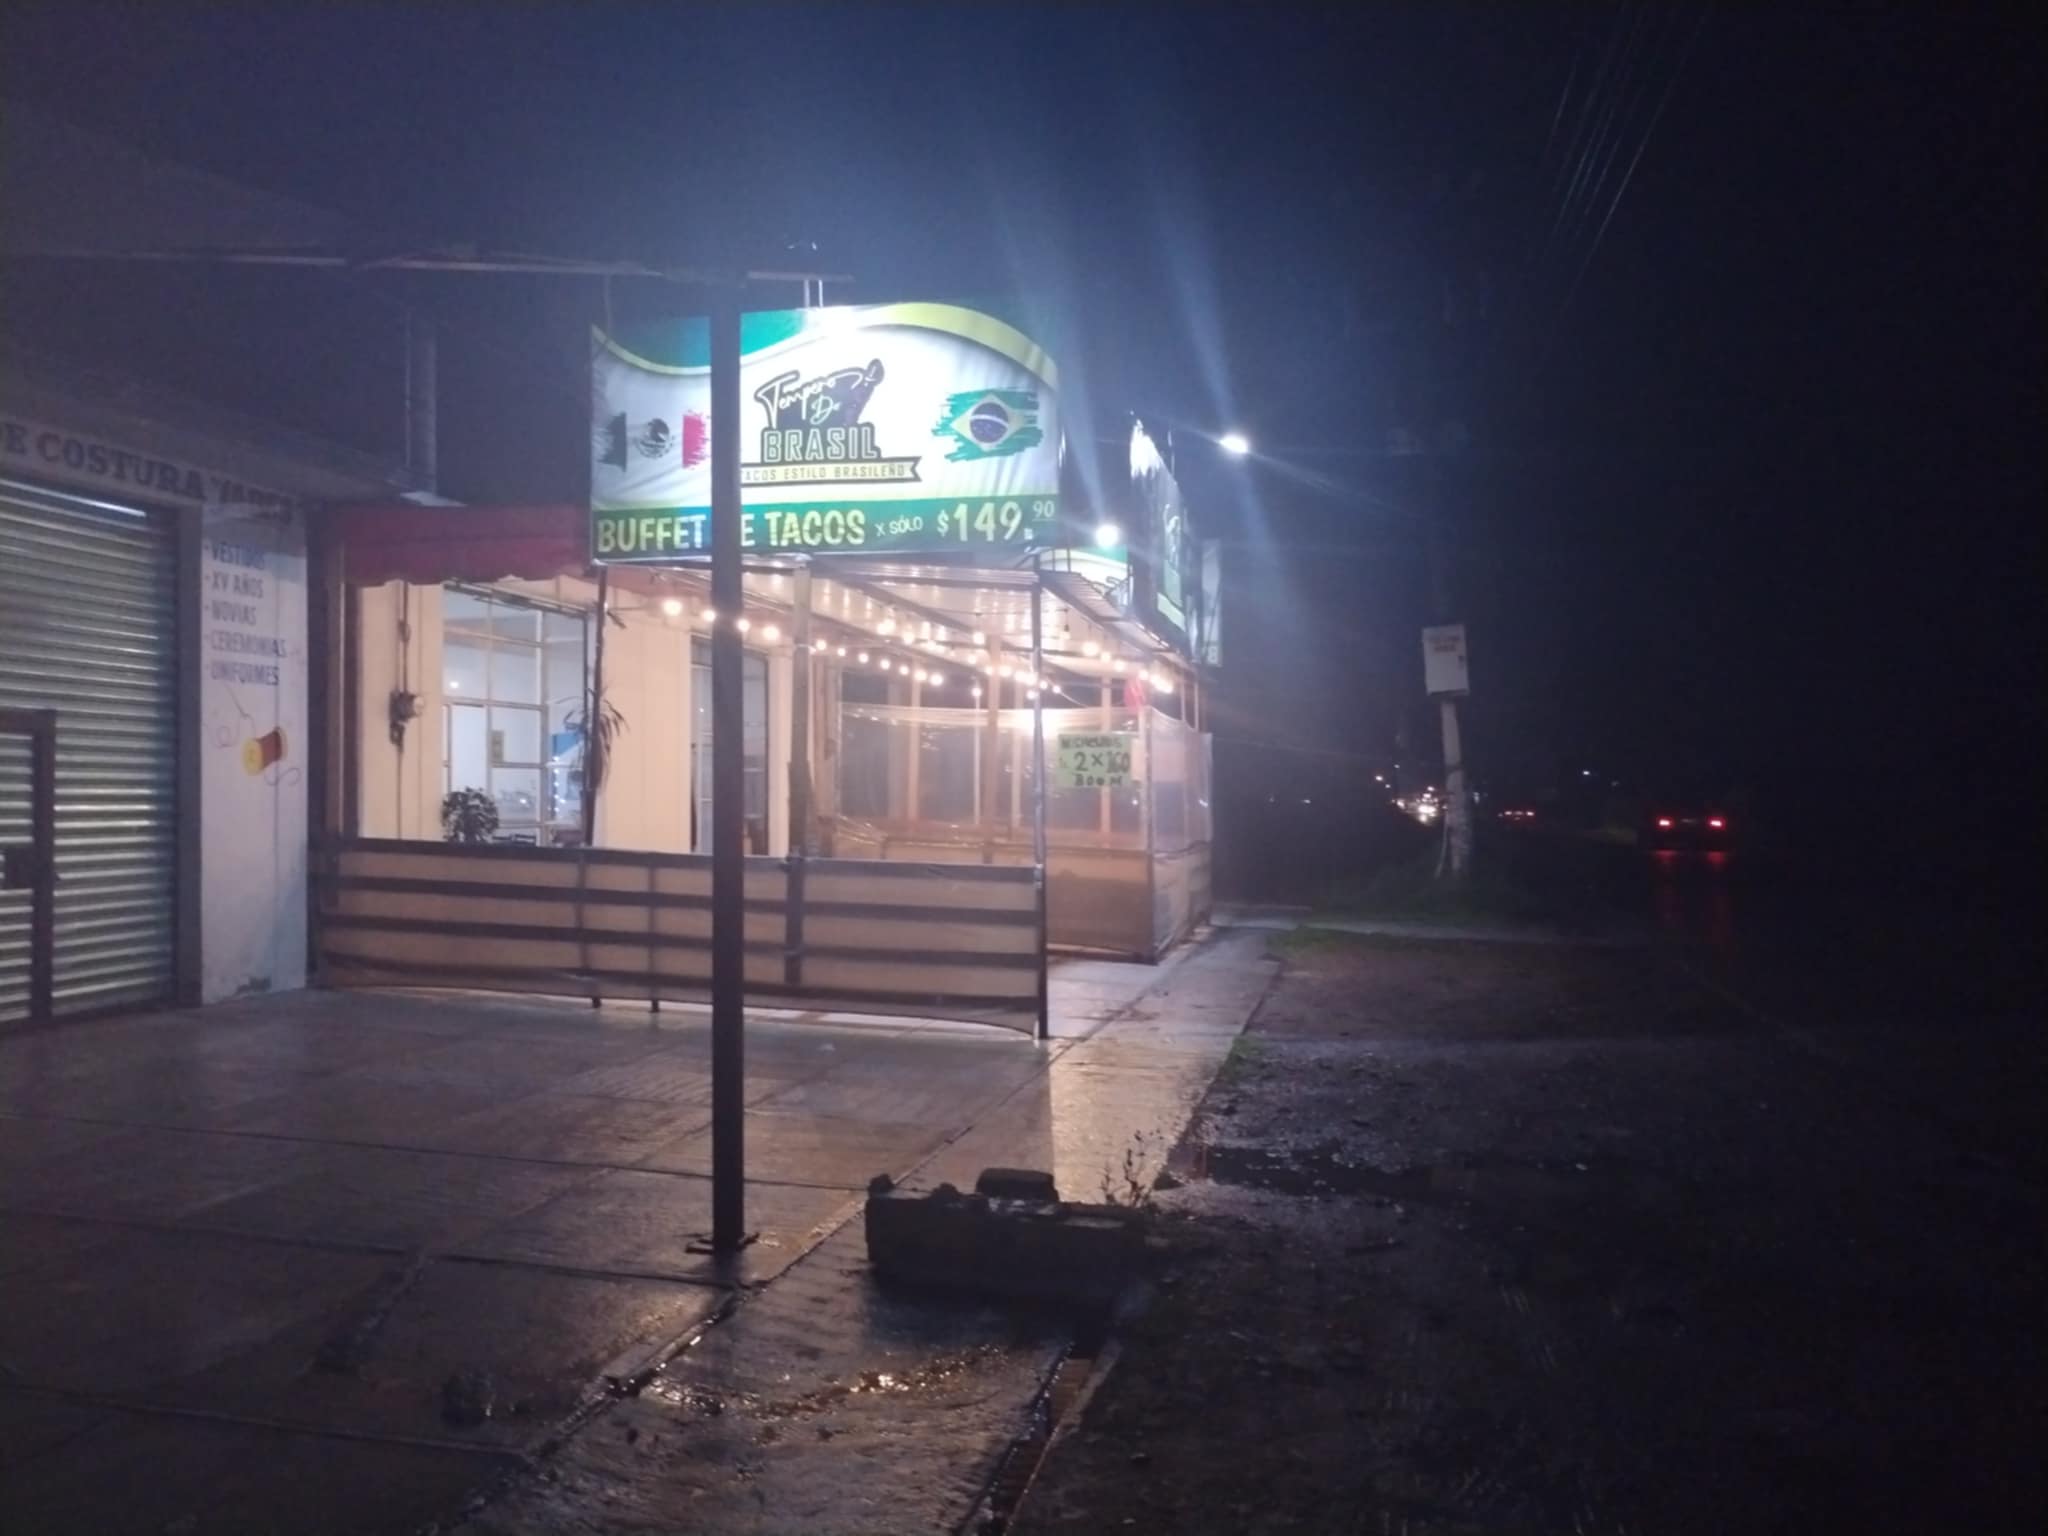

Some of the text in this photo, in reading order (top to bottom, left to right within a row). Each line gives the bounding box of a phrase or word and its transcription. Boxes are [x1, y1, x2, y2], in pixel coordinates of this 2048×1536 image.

[0, 421, 29, 455] E
[36, 430, 206, 500] COSTURA
[763, 426, 878, 463] BRASIL
[743, 462, 906, 482] ACOS ESTILO BRASILEÑO
[598, 514, 707, 553] BUFFET
[741, 513, 755, 547] E
[764, 508, 866, 548] TACOS
[889, 515, 924, 536] SÓLO
[212, 570, 265, 600] XV AÑOS
[211, 600, 257, 627] NOVIAS
